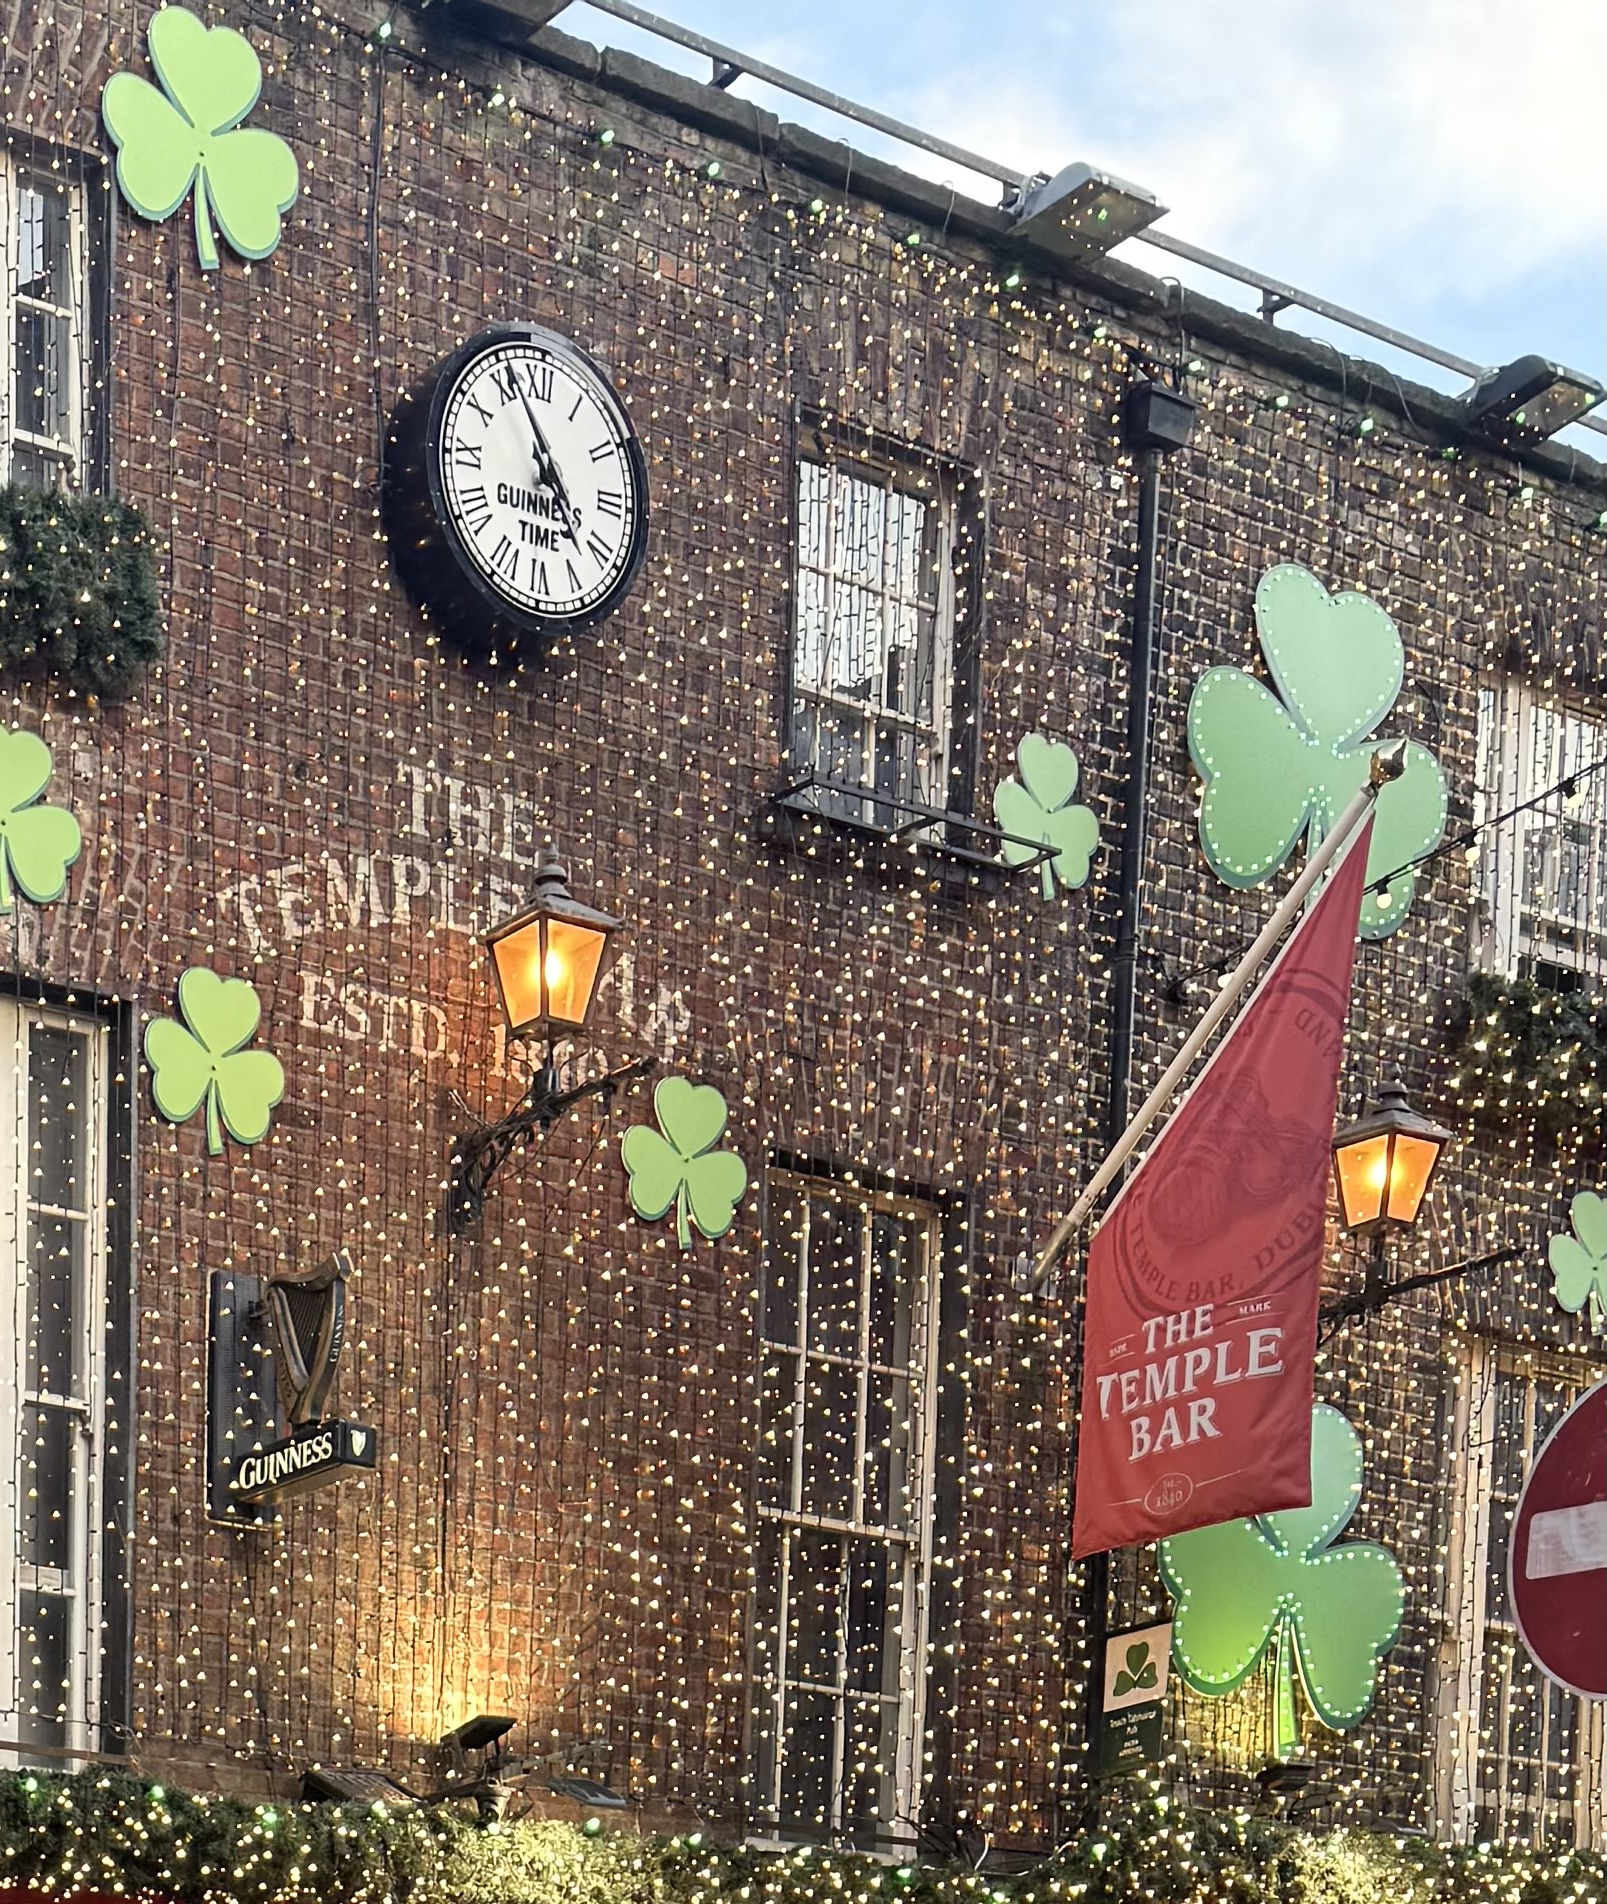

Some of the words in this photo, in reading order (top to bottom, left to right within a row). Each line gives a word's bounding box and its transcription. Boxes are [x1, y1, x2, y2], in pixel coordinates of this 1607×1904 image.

[518, 520, 561, 553] TIME
[397, 762, 541, 867] THE
[216, 855, 524, 954] TEMPLE
[1141, 1303, 1215, 1355] THE
[1096, 1327, 1285, 1421] TEMPLE
[239, 1431, 334, 1491] GUINNESS
[1128, 1397, 1223, 1464] BAR
